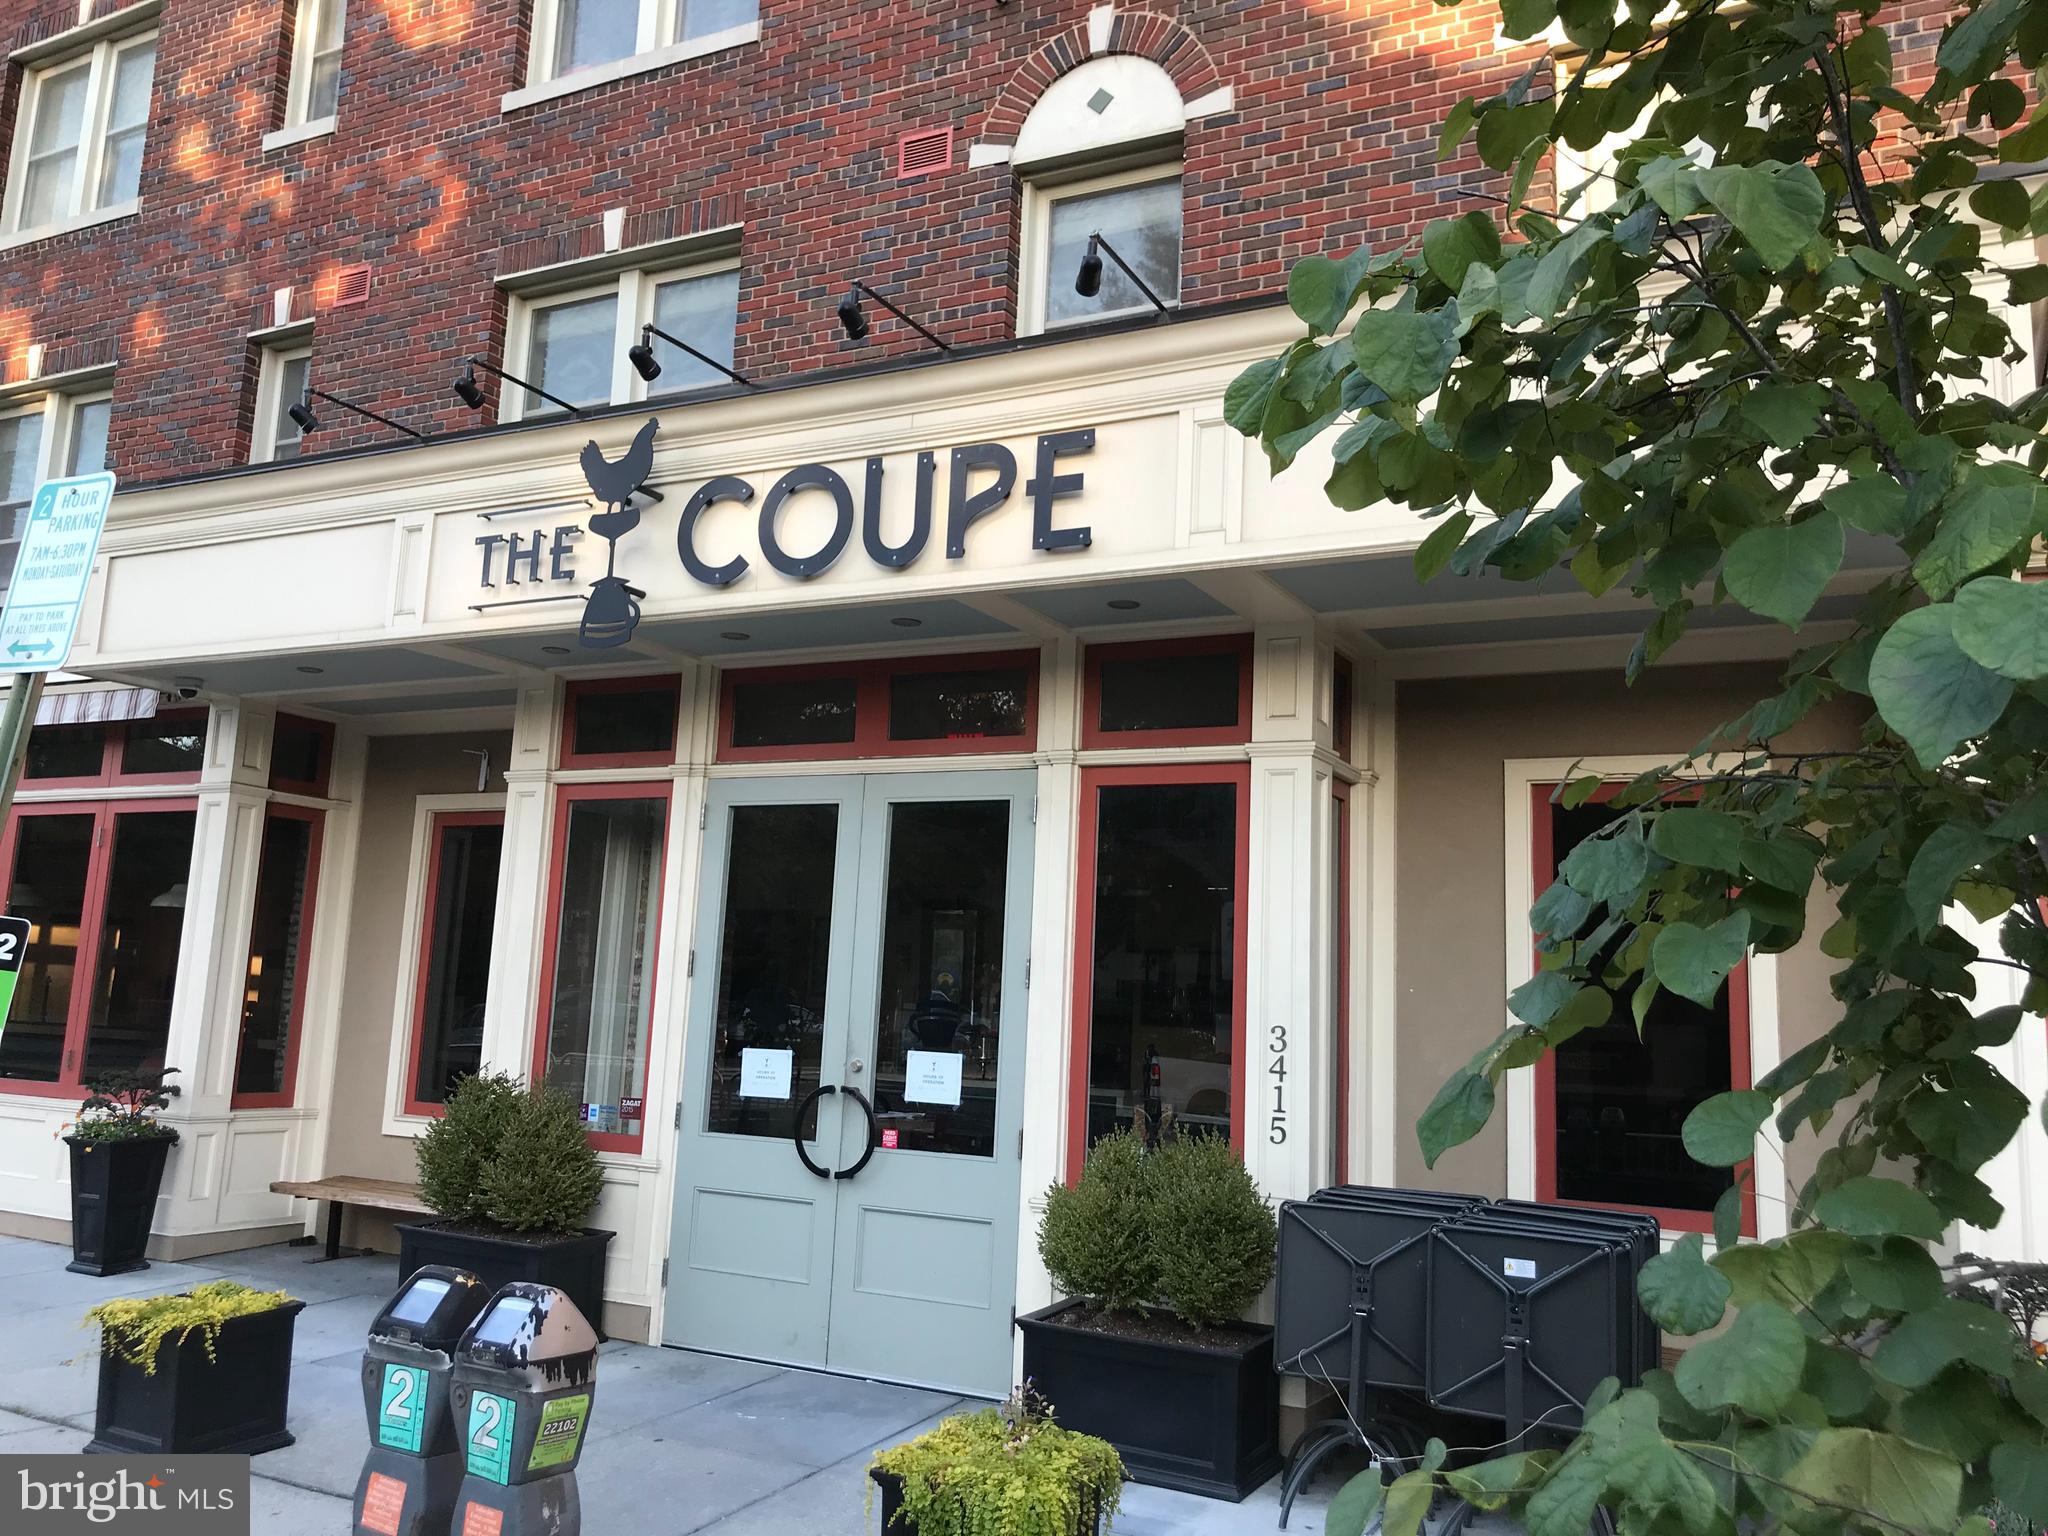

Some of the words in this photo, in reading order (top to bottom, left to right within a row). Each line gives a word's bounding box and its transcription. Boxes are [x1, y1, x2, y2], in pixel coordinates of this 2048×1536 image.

[39, 494, 52, 518] 2
[62, 490, 100, 510] HOUR
[474, 524, 585, 588] THE
[676, 427, 1097, 587] COUPE
[48, 511, 100, 534] PARKING
[23, 563, 84, 582] MONDAY-SATURDAY
[19, 612, 34, 624] PAY
[35, 611, 45, 623] TO
[46, 610, 65, 621] PARK
[29, 623, 47, 634] TIMES
[48, 622, 67, 633] ABOVE
[1268, 1025, 1288, 1145] 3415
[620, 1099, 642, 1107] ZAGAT
[385, 1367, 415, 1420] 2
[472, 1396, 502, 1451] 2
[543, 1417, 577, 1435] 22102
